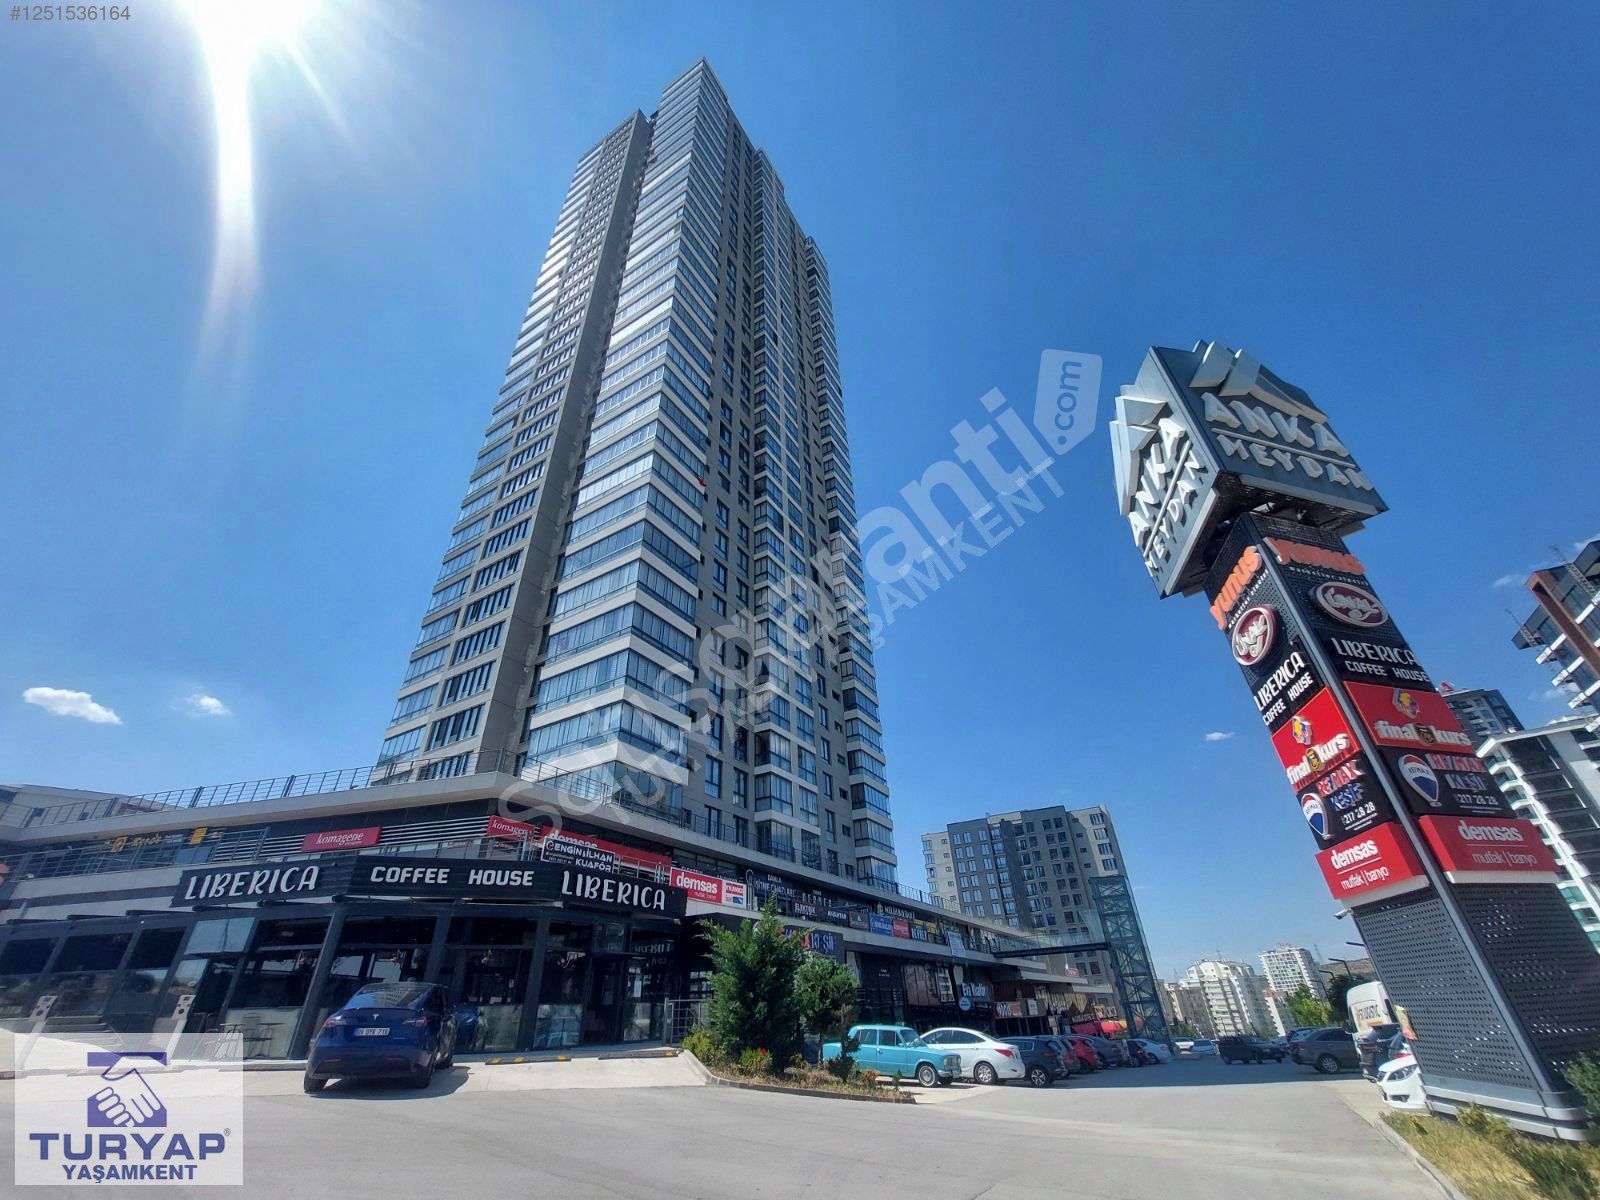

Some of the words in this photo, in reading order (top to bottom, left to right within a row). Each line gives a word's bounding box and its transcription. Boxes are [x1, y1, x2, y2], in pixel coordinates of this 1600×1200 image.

[1201, 392, 1350, 458] ANKA
[1216, 434, 1373, 491] MEYDAN
[1128, 418, 1186, 547] ANKA
[1145, 450, 1204, 577] MEYDAN
[1210, 545, 1263, 630] yunus
[1331, 638, 1421, 667] LIBERICA
[1254, 651, 1305, 710] LIBERICA
[1345, 660, 1388, 676] COFFEE
[1392, 667, 1431, 682] HOUSE
[1262, 698, 1288, 726] COFFEE
[1287, 672, 1314, 702] HOUSE
[1430, 724, 1472, 746] kurs
[1286, 755, 1312, 784] final
[1316, 733, 1349, 763] kurs
[1343, 812, 1355, 824] 217
[1354, 806, 1366, 819] 28
[1364, 801, 1376, 814] 28
[315, 832, 364, 846] komagene
[1458, 820, 1524, 842] demsas
[1330, 839, 1379, 869] demsas
[185, 865, 320, 900] LIBERICA
[370, 866, 450, 884] COFFEE
[469, 869, 535, 886] HOUSE
[562, 870, 666, 911] LIBERICA
[676, 872, 718, 894] demsas
[1341, 873, 1364, 890] mutfak
[1365, 866, 1390, 883] banyo
